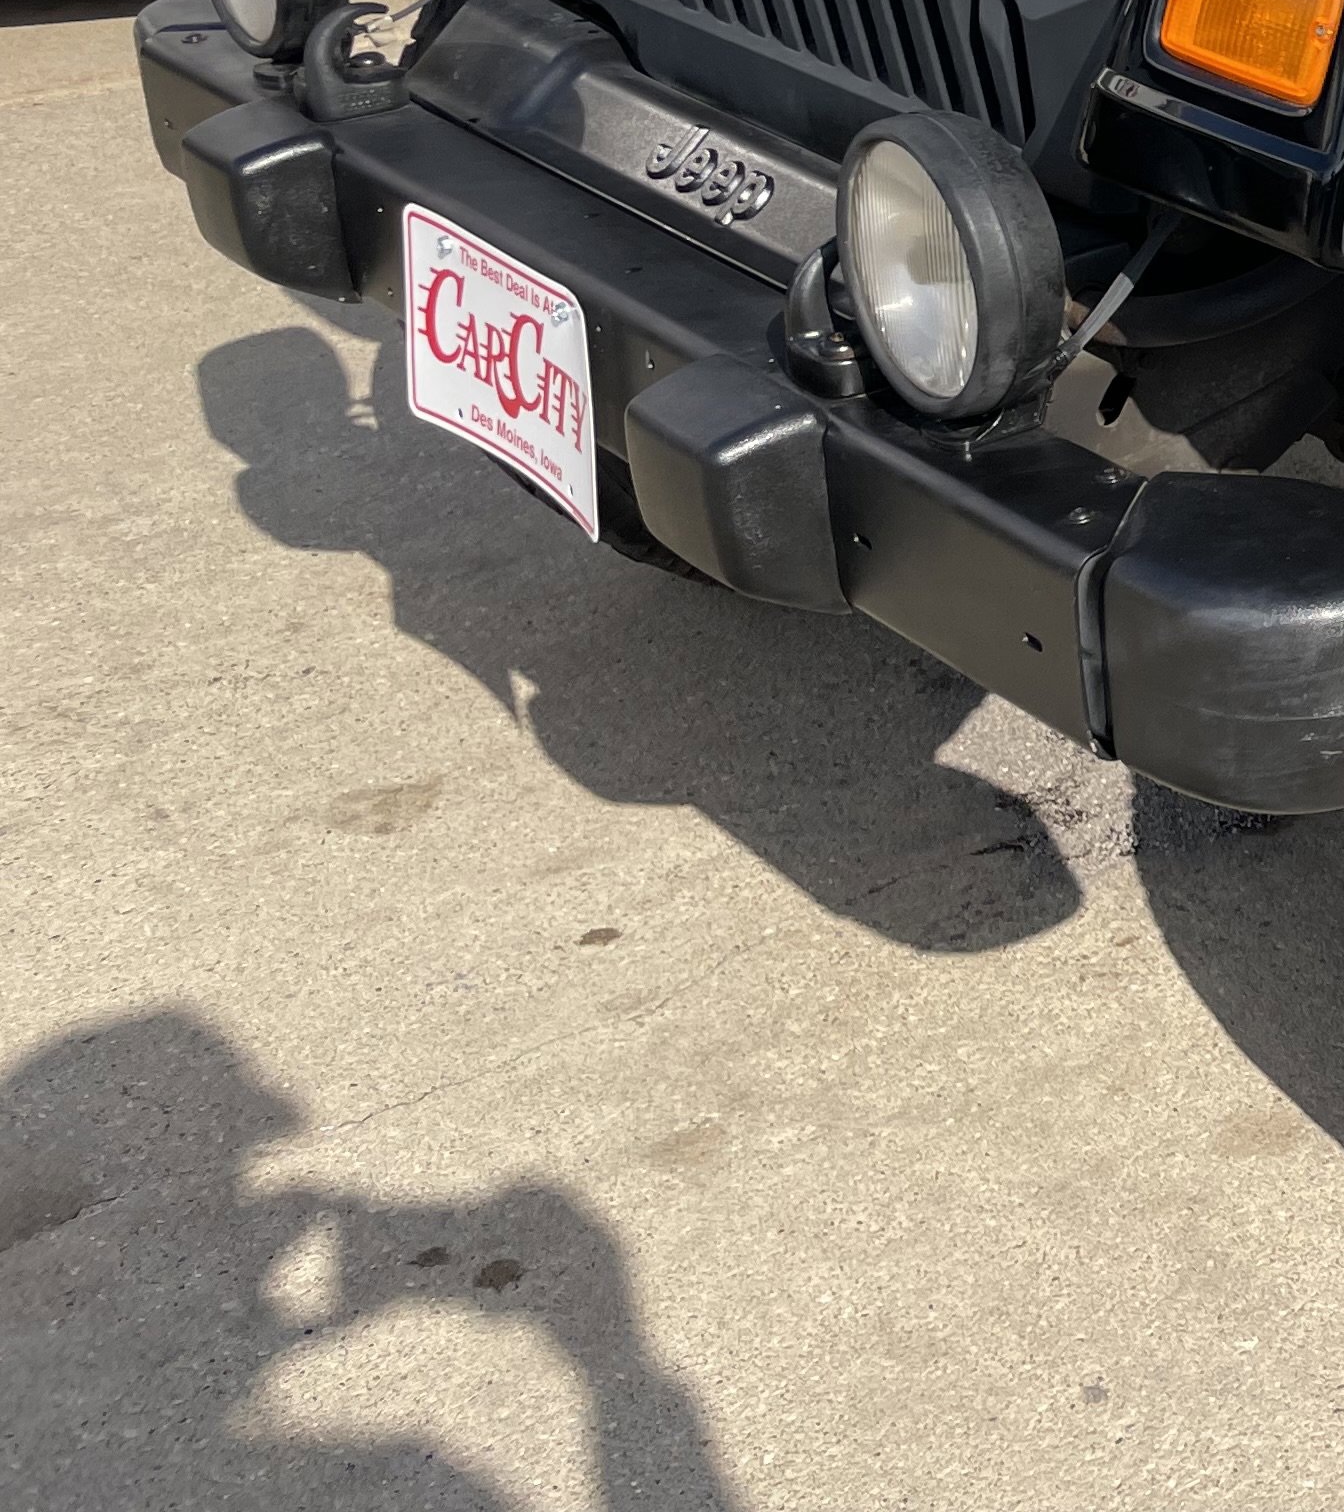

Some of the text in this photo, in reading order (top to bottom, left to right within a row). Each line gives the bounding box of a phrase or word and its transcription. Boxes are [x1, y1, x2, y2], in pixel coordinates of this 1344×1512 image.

[645, 124, 775, 227] Jeep
[459, 245, 478, 271] The
[480, 256, 504, 288] Best
[505, 272, 529, 302] Deal
[531, 288, 541, 309] Is
[471, 403, 563, 482] Des Moines, Iowa
